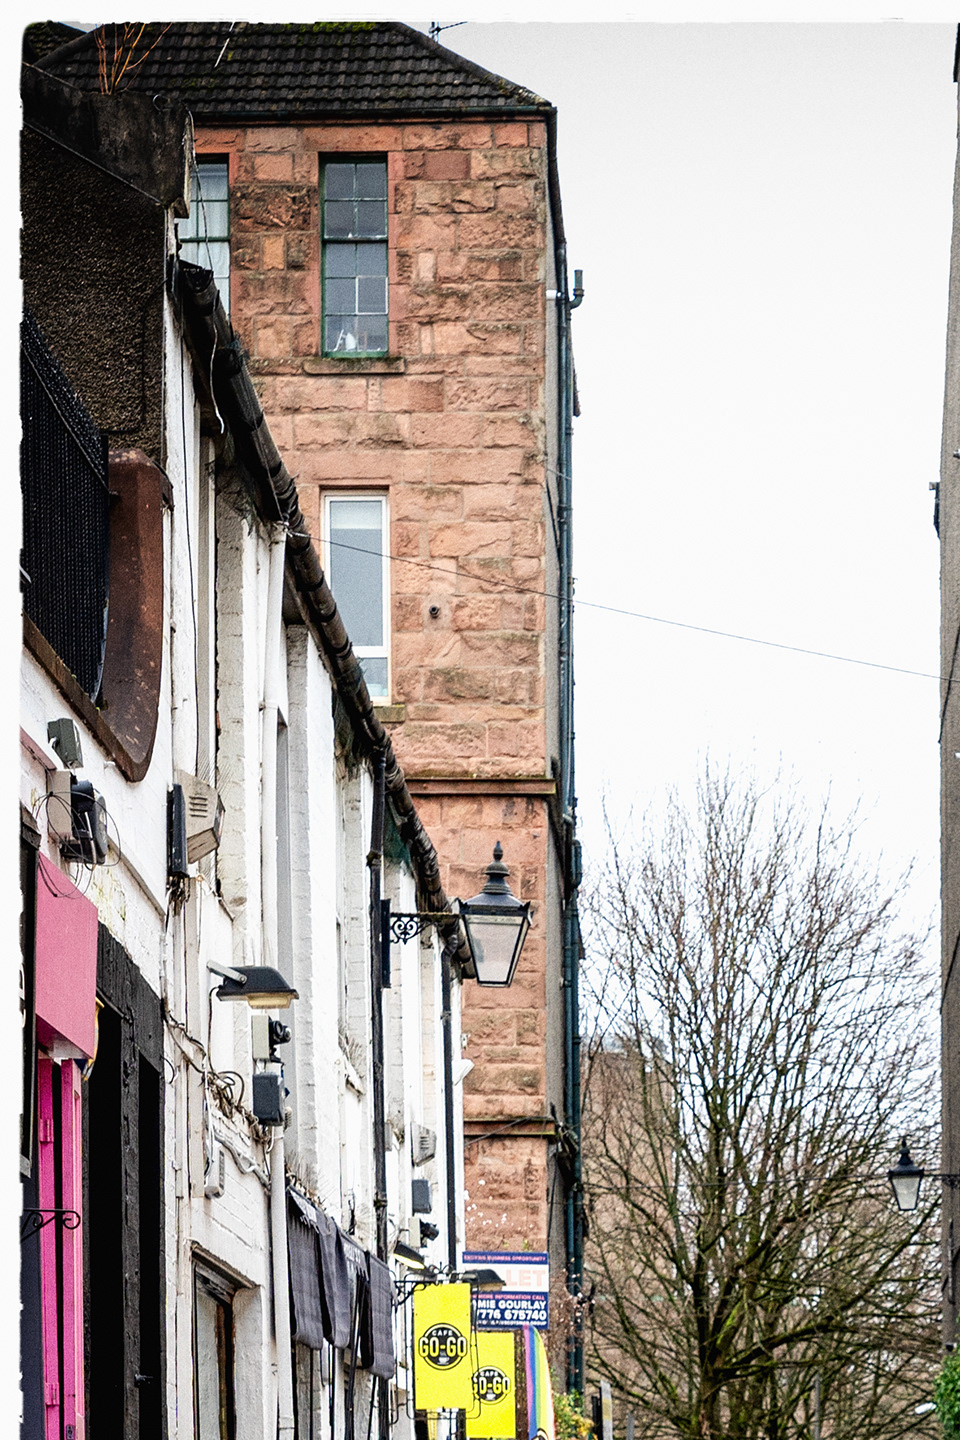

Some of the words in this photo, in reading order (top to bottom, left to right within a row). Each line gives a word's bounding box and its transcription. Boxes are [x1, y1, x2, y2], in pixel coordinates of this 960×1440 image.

[505, 1269, 547, 1287] LET
[498, 1300, 547, 1310] GOURLAY
[477, 1309, 501, 1320] 776
[503, 1309, 547, 1321] 675740
[431, 1329, 453, 1337] CAFE
[419, 1336, 468, 1358] GO-GO
